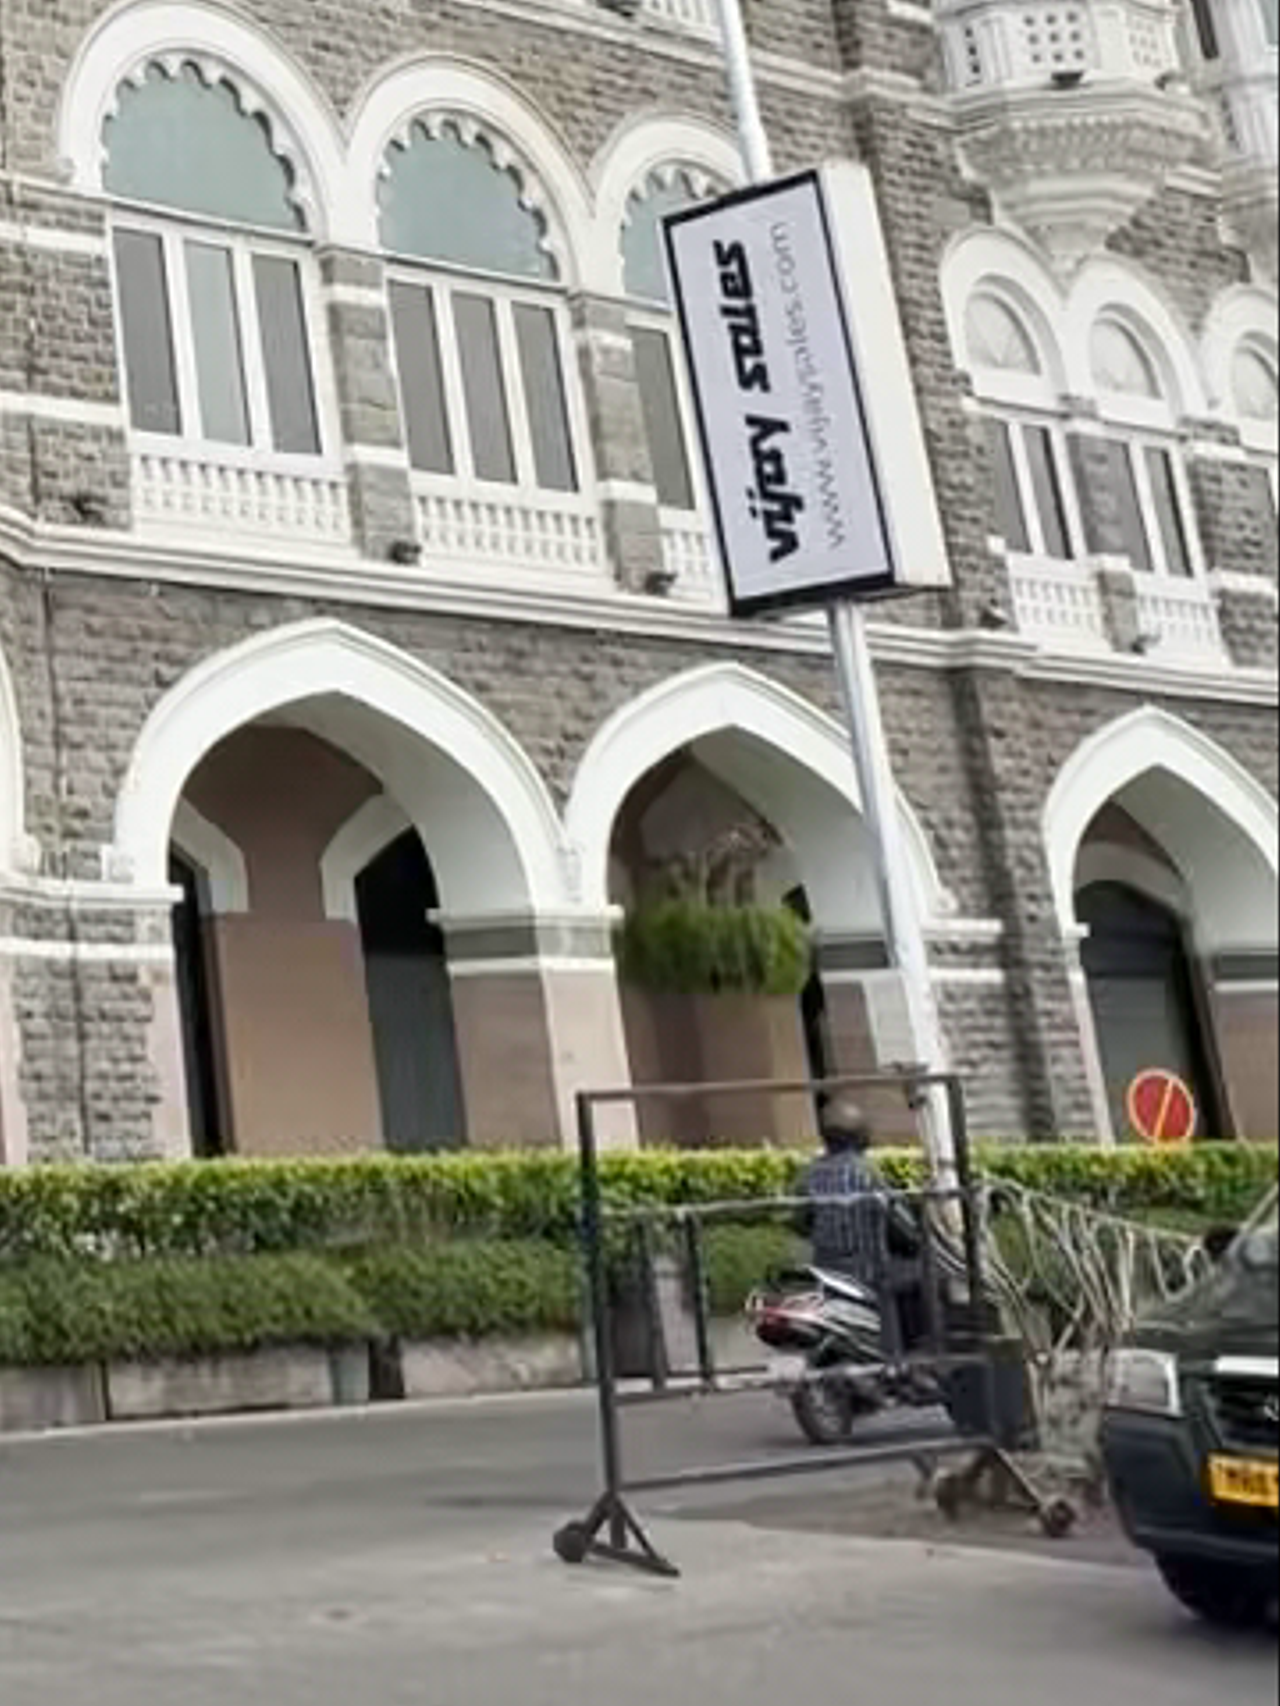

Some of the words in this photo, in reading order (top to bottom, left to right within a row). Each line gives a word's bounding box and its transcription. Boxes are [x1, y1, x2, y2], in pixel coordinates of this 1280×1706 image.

[711, 239, 772, 394] sales
[770, 220, 847, 554] www.vijaysales.com
[743, 413, 806, 565] vijay
